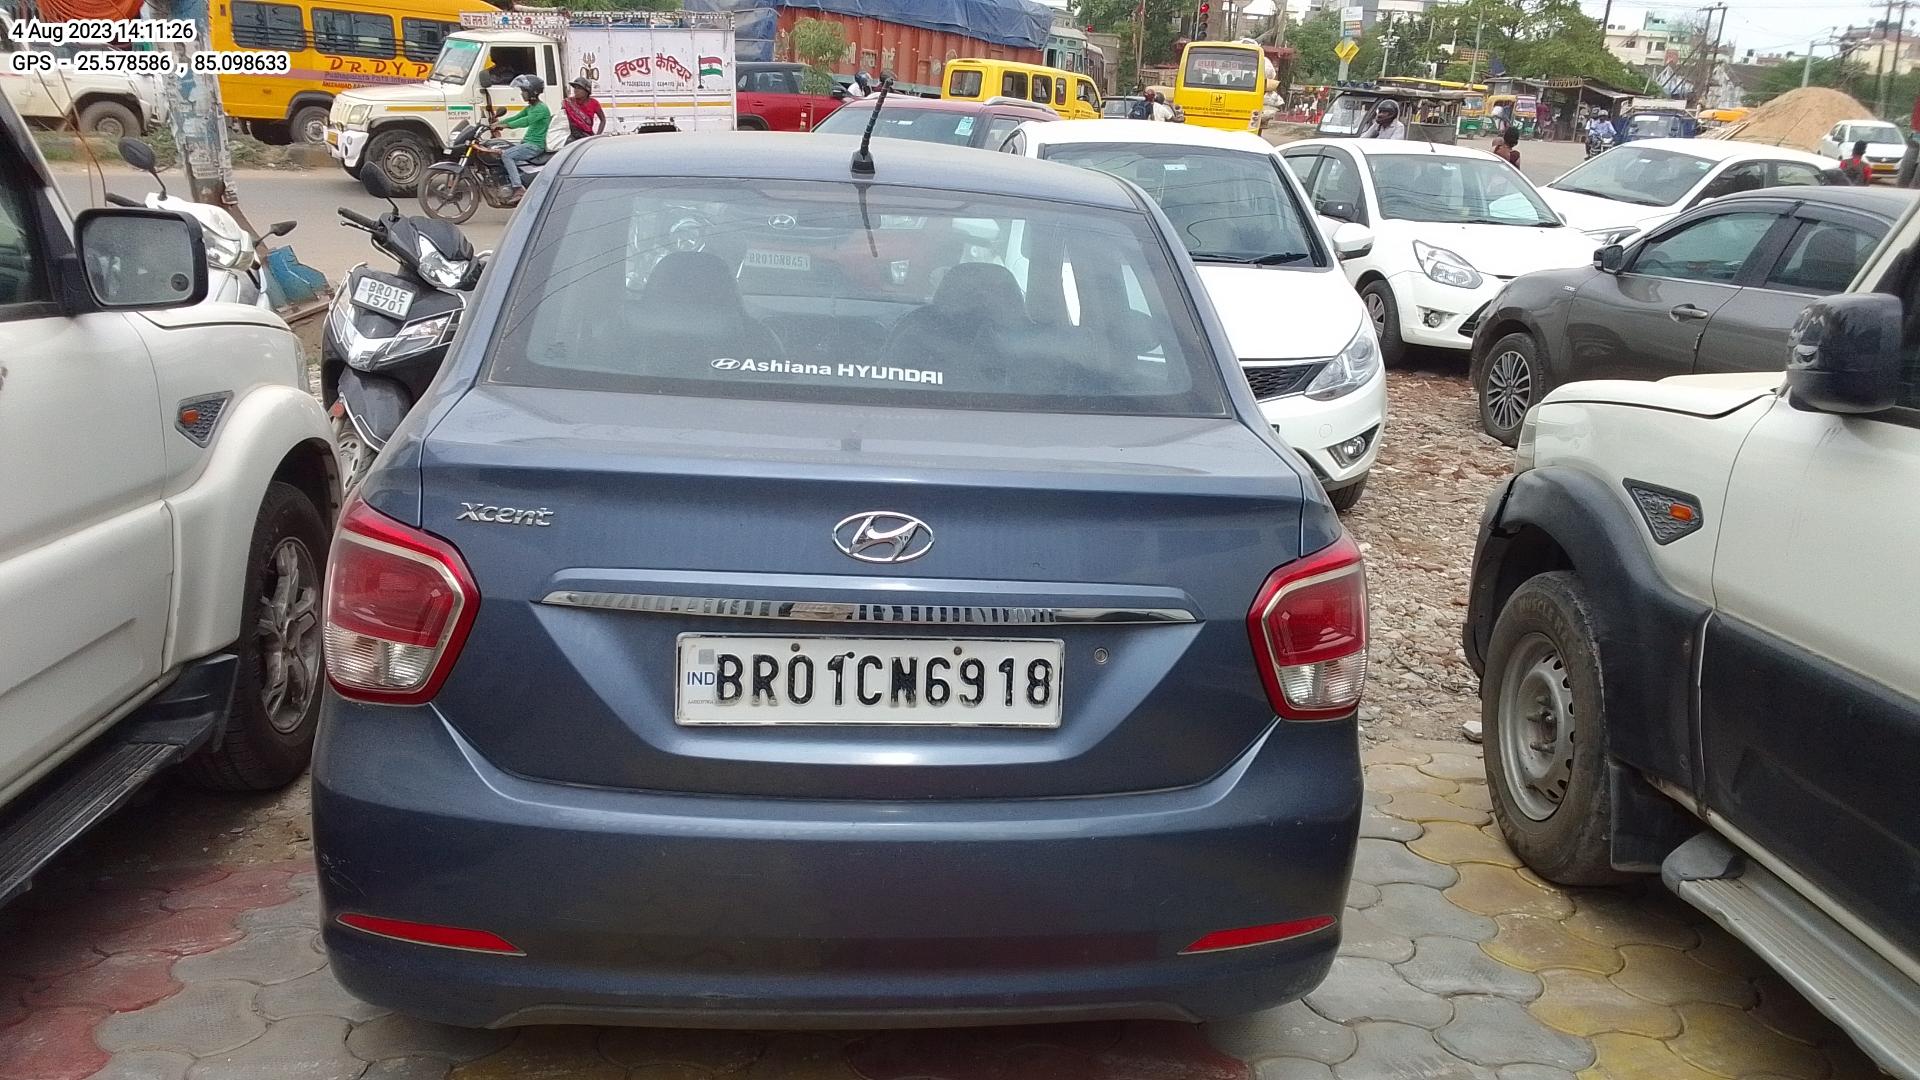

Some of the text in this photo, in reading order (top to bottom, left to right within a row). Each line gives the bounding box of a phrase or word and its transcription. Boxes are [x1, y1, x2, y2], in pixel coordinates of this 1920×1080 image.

[614, 56, 651, 83] विष्णु
[366, 292, 403, 313] Y5701
[368, 281, 408, 303] BR01E
[740, 358, 944, 385] Ashiana HYUNDAI
[456, 502, 555, 527] Xcent
[687, 671, 716, 686] IND
[716, 653, 1053, 707] BR01CN6918
